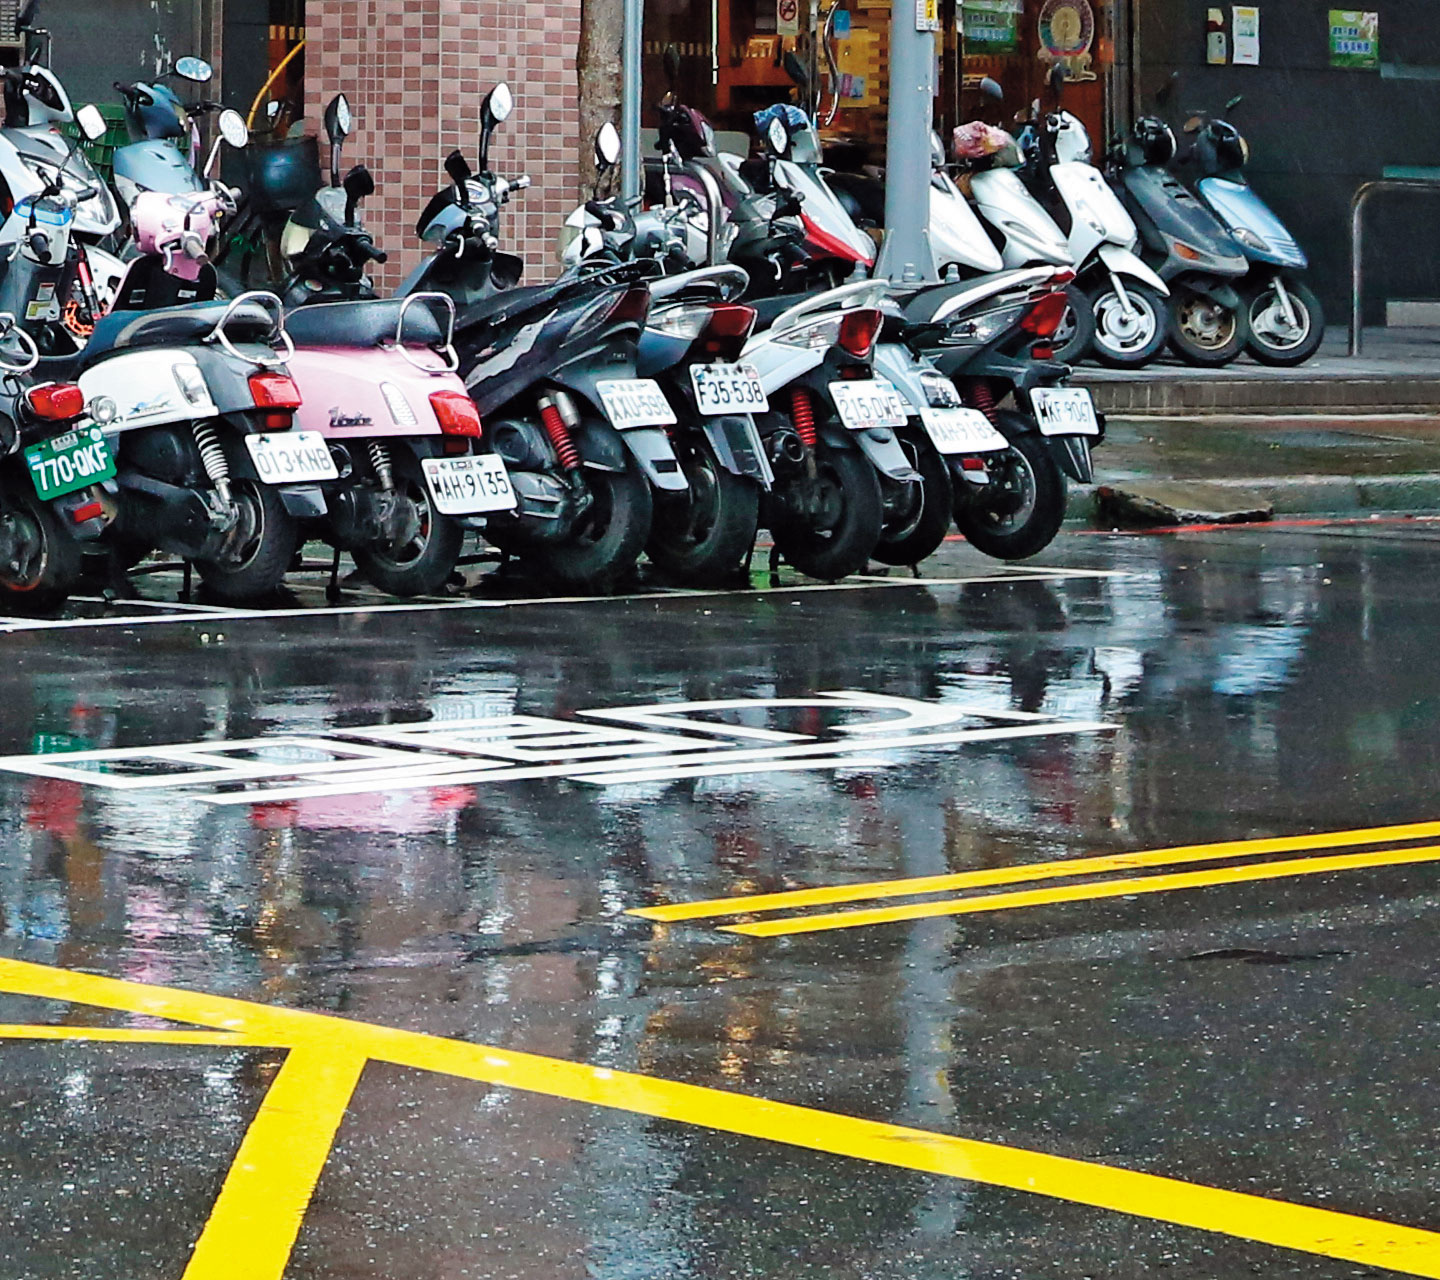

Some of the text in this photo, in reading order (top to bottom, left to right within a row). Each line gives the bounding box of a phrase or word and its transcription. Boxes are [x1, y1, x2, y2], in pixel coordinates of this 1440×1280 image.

[697, 380, 765, 406] F35-538
[32, 440, 108, 491] 770-QKF
[256, 448, 333, 476] 013-KNB
[430, 470, 510, 501] MAH-9135
